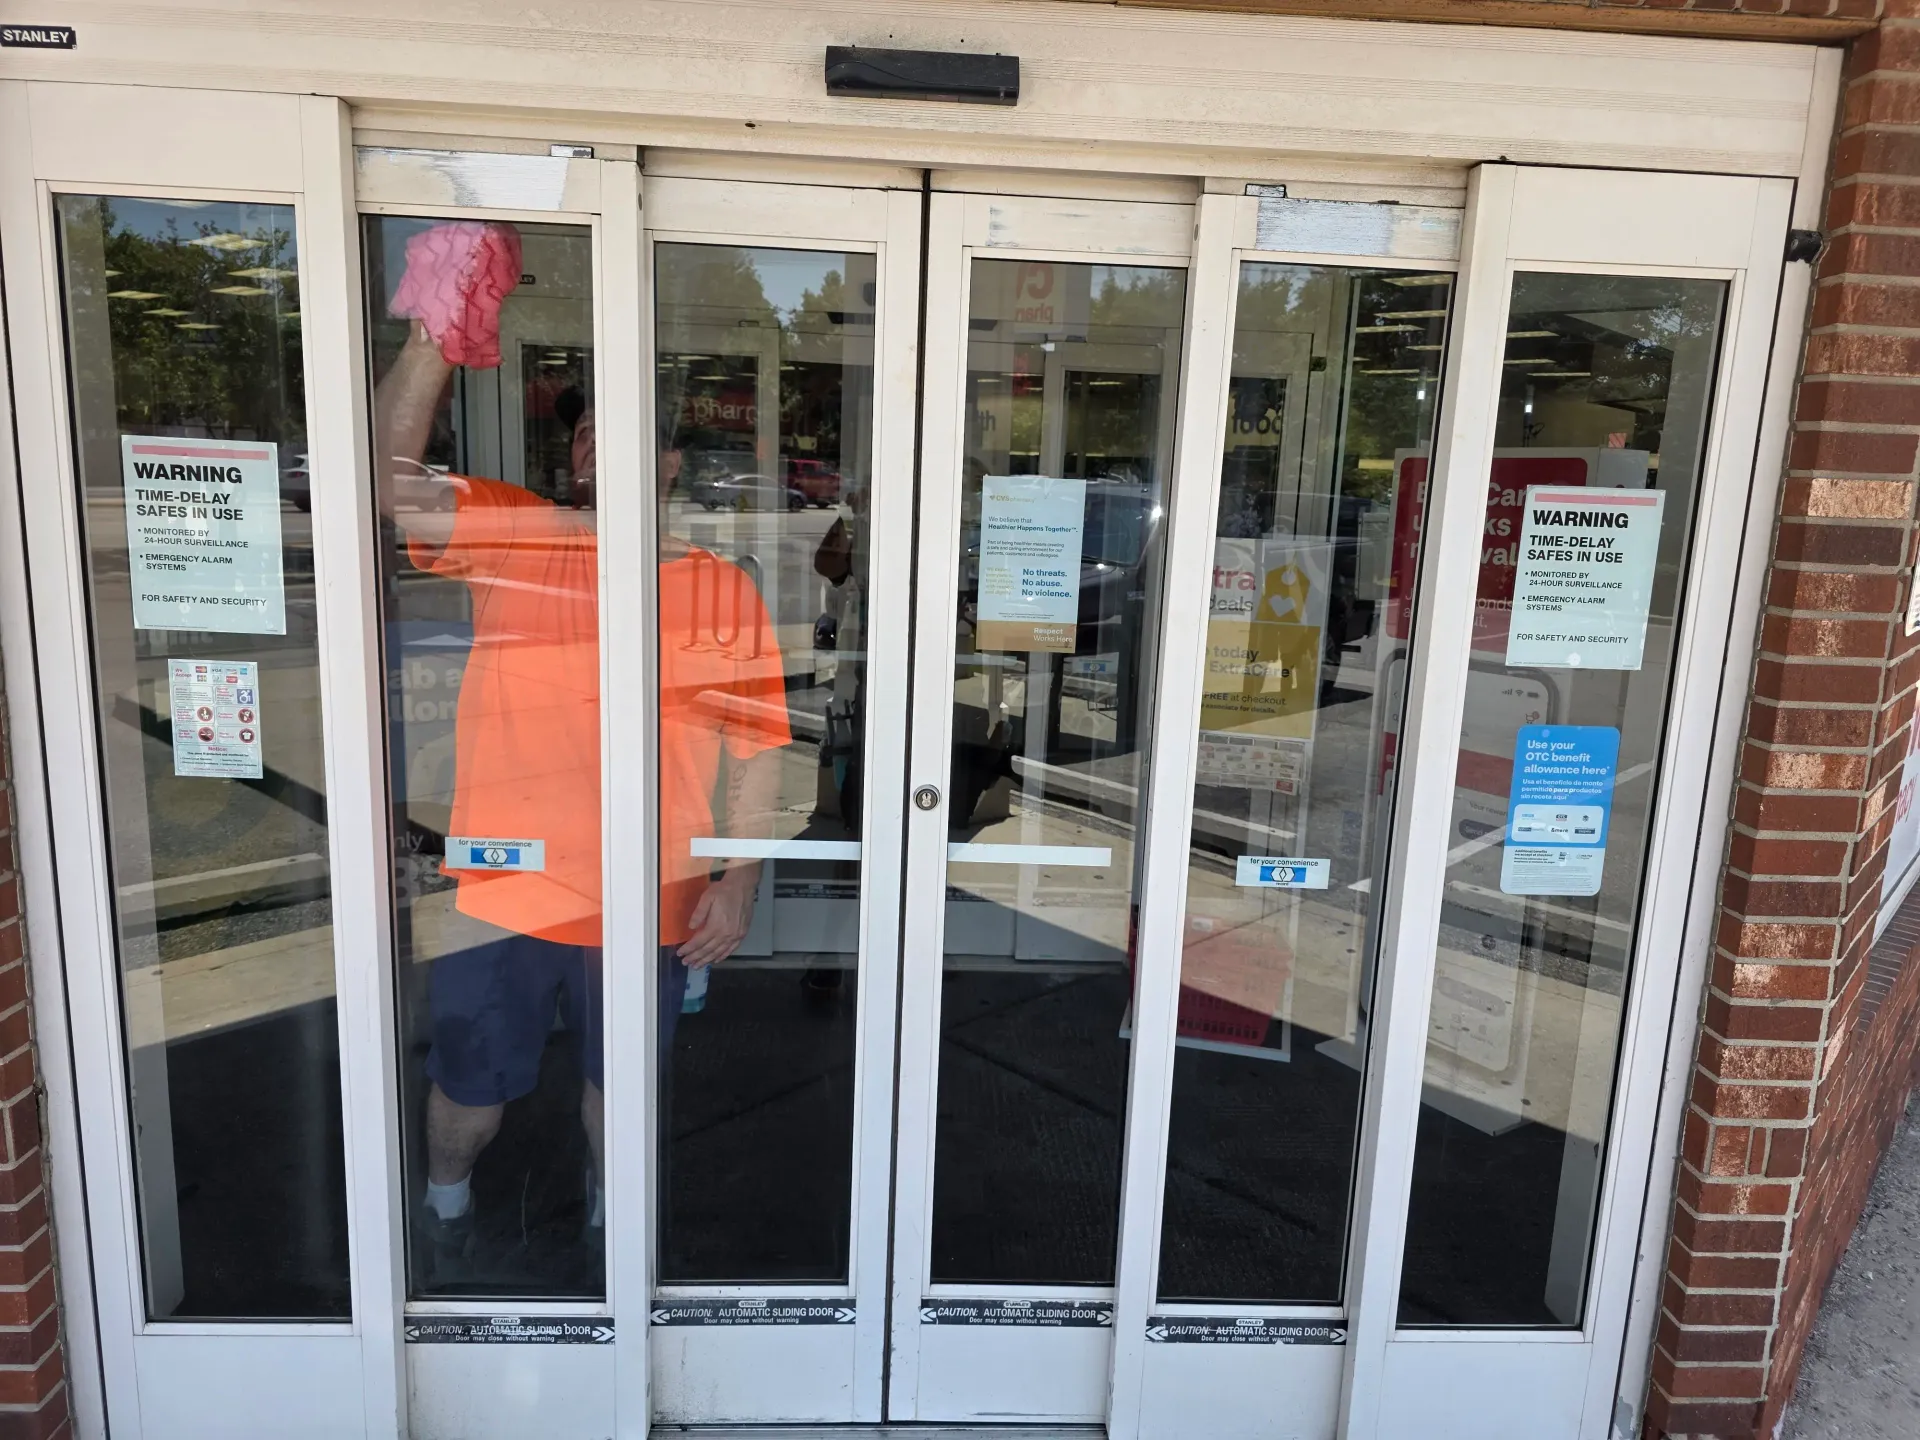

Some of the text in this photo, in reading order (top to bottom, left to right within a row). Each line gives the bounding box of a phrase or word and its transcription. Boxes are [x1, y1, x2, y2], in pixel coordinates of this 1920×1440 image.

[2, 29, 70, 43] STANLEY
[133, 462, 243, 484] WARNING
[135, 488, 231, 505] TIME-DELAY
[136, 505, 243, 521] SAFES IN USE
[1533, 509, 1629, 528] WARNING
[143, 527, 210, 537] MONITORED BY
[988, 523, 1016, 531] Healthier
[144, 537, 249, 548] 24-HOUR SURVEILLANCE
[1529, 535, 1615, 549] TIME-DELAY
[145, 553, 233, 565] EMERGENCY ALARM
[1527, 549, 1623, 563] SAFES IN USE
[146, 563, 187, 571] SYSTEMS
[1022, 568, 1068, 577] No threats.
[1212, 565, 1256, 591] tra
[1530, 570, 1577, 579] MONITORED
[1022, 578, 1063, 587] No abuse.
[1529, 579, 1623, 589] 24-HOUR SURVEILLANCE
[1034, 589, 1072, 598] violence.
[142, 594, 267, 607] FOR SAFETY AND SECURITY
[1527, 595, 1605, 605] EMERGENCY ALARM
[1526, 603, 1563, 611] SYSTEMS
[1033, 627, 1063, 636] Respect
[1516, 633, 1628, 644] FOR SAFETY AND SECURITY
[1214, 646, 1259, 662] today
[1527, 739, 1575, 751] Use your
[1525, 752, 1591, 762] OTC benefit
[1523, 764, 1580, 774] allowance
[488, 840, 532, 848] convenience
[671, 1307, 834, 1318] CAUTION: AUTOMATIC SLIDING DOOR
[938, 1307, 1096, 1319] CAUTION: AUTOMATIC SLIDING DOOR
[1039, 1318, 1062, 1326] warning
[470, 1325, 526, 1336] AUTOMATIC
[527, 1325, 562, 1336] SLIDING
[564, 1325, 591, 1335] DOOR
[1169, 1325, 1329, 1337] CAUTION: AUTOMATIC SLIDING DOOR
